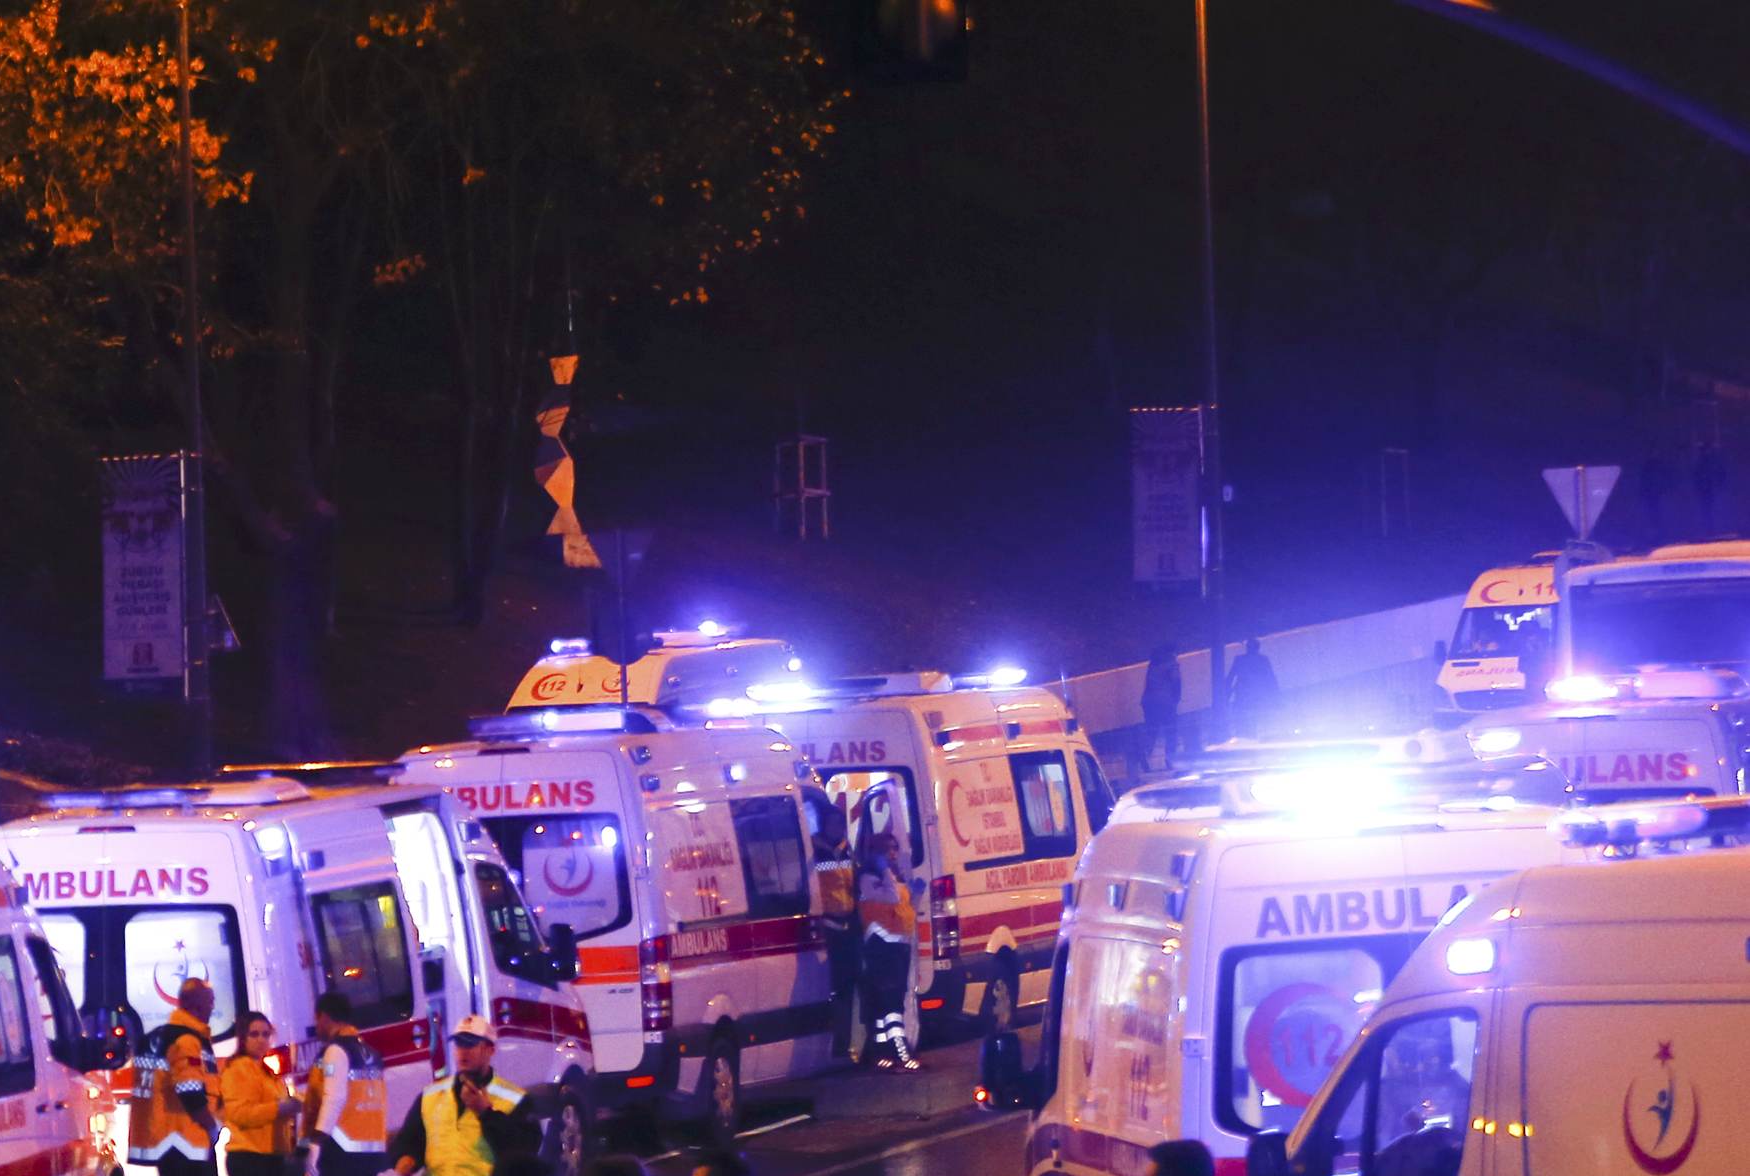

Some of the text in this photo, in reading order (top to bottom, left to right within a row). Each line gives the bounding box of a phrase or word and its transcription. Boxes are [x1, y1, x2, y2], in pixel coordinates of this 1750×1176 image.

[1535, 582, 1554, 597] 11
[540, 680, 566, 692] 112
[802, 741, 886, 764] LANS
[1561, 752, 1688, 783] ULANS
[456, 781, 595, 812] BULANS
[23, 867, 209, 900] MBULANS
[1277, 1023, 1343, 1068] 112
